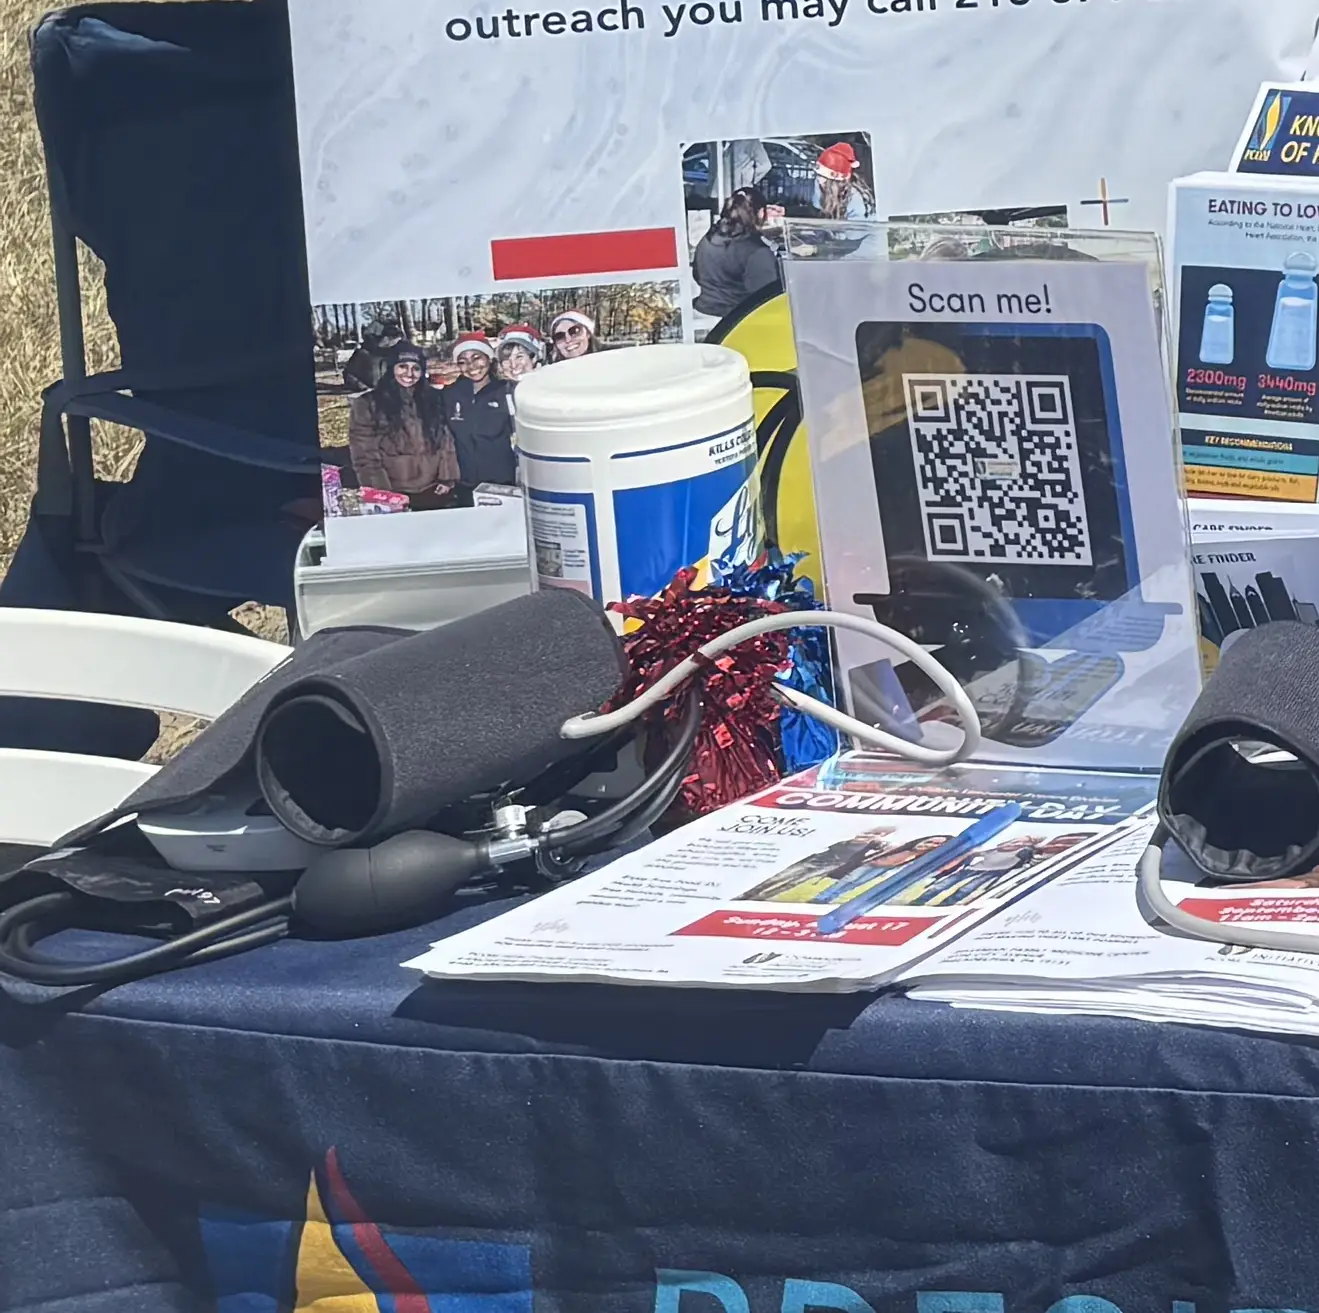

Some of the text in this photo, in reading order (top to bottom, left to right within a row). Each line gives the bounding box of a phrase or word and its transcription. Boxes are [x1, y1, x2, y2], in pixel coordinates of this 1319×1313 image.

[1280, 141, 1311, 163] OF
[1208, 199, 1267, 216] EATING
[1272, 202, 1293, 217] TO
[907, 283, 1053, 314] Scan me!
[1186, 368, 1247, 390] 2300mg
[1257, 374, 1317, 396] 3440mg
[709, 438, 735, 456] KILLS
[1207, 552, 1257, 564] FINDER
[1028, 801, 1122, 820] DAY
[741, 814, 811, 826] COME
[719, 824, 816, 838] JOIN US!
[723, 916, 801, 928] Sunday,
